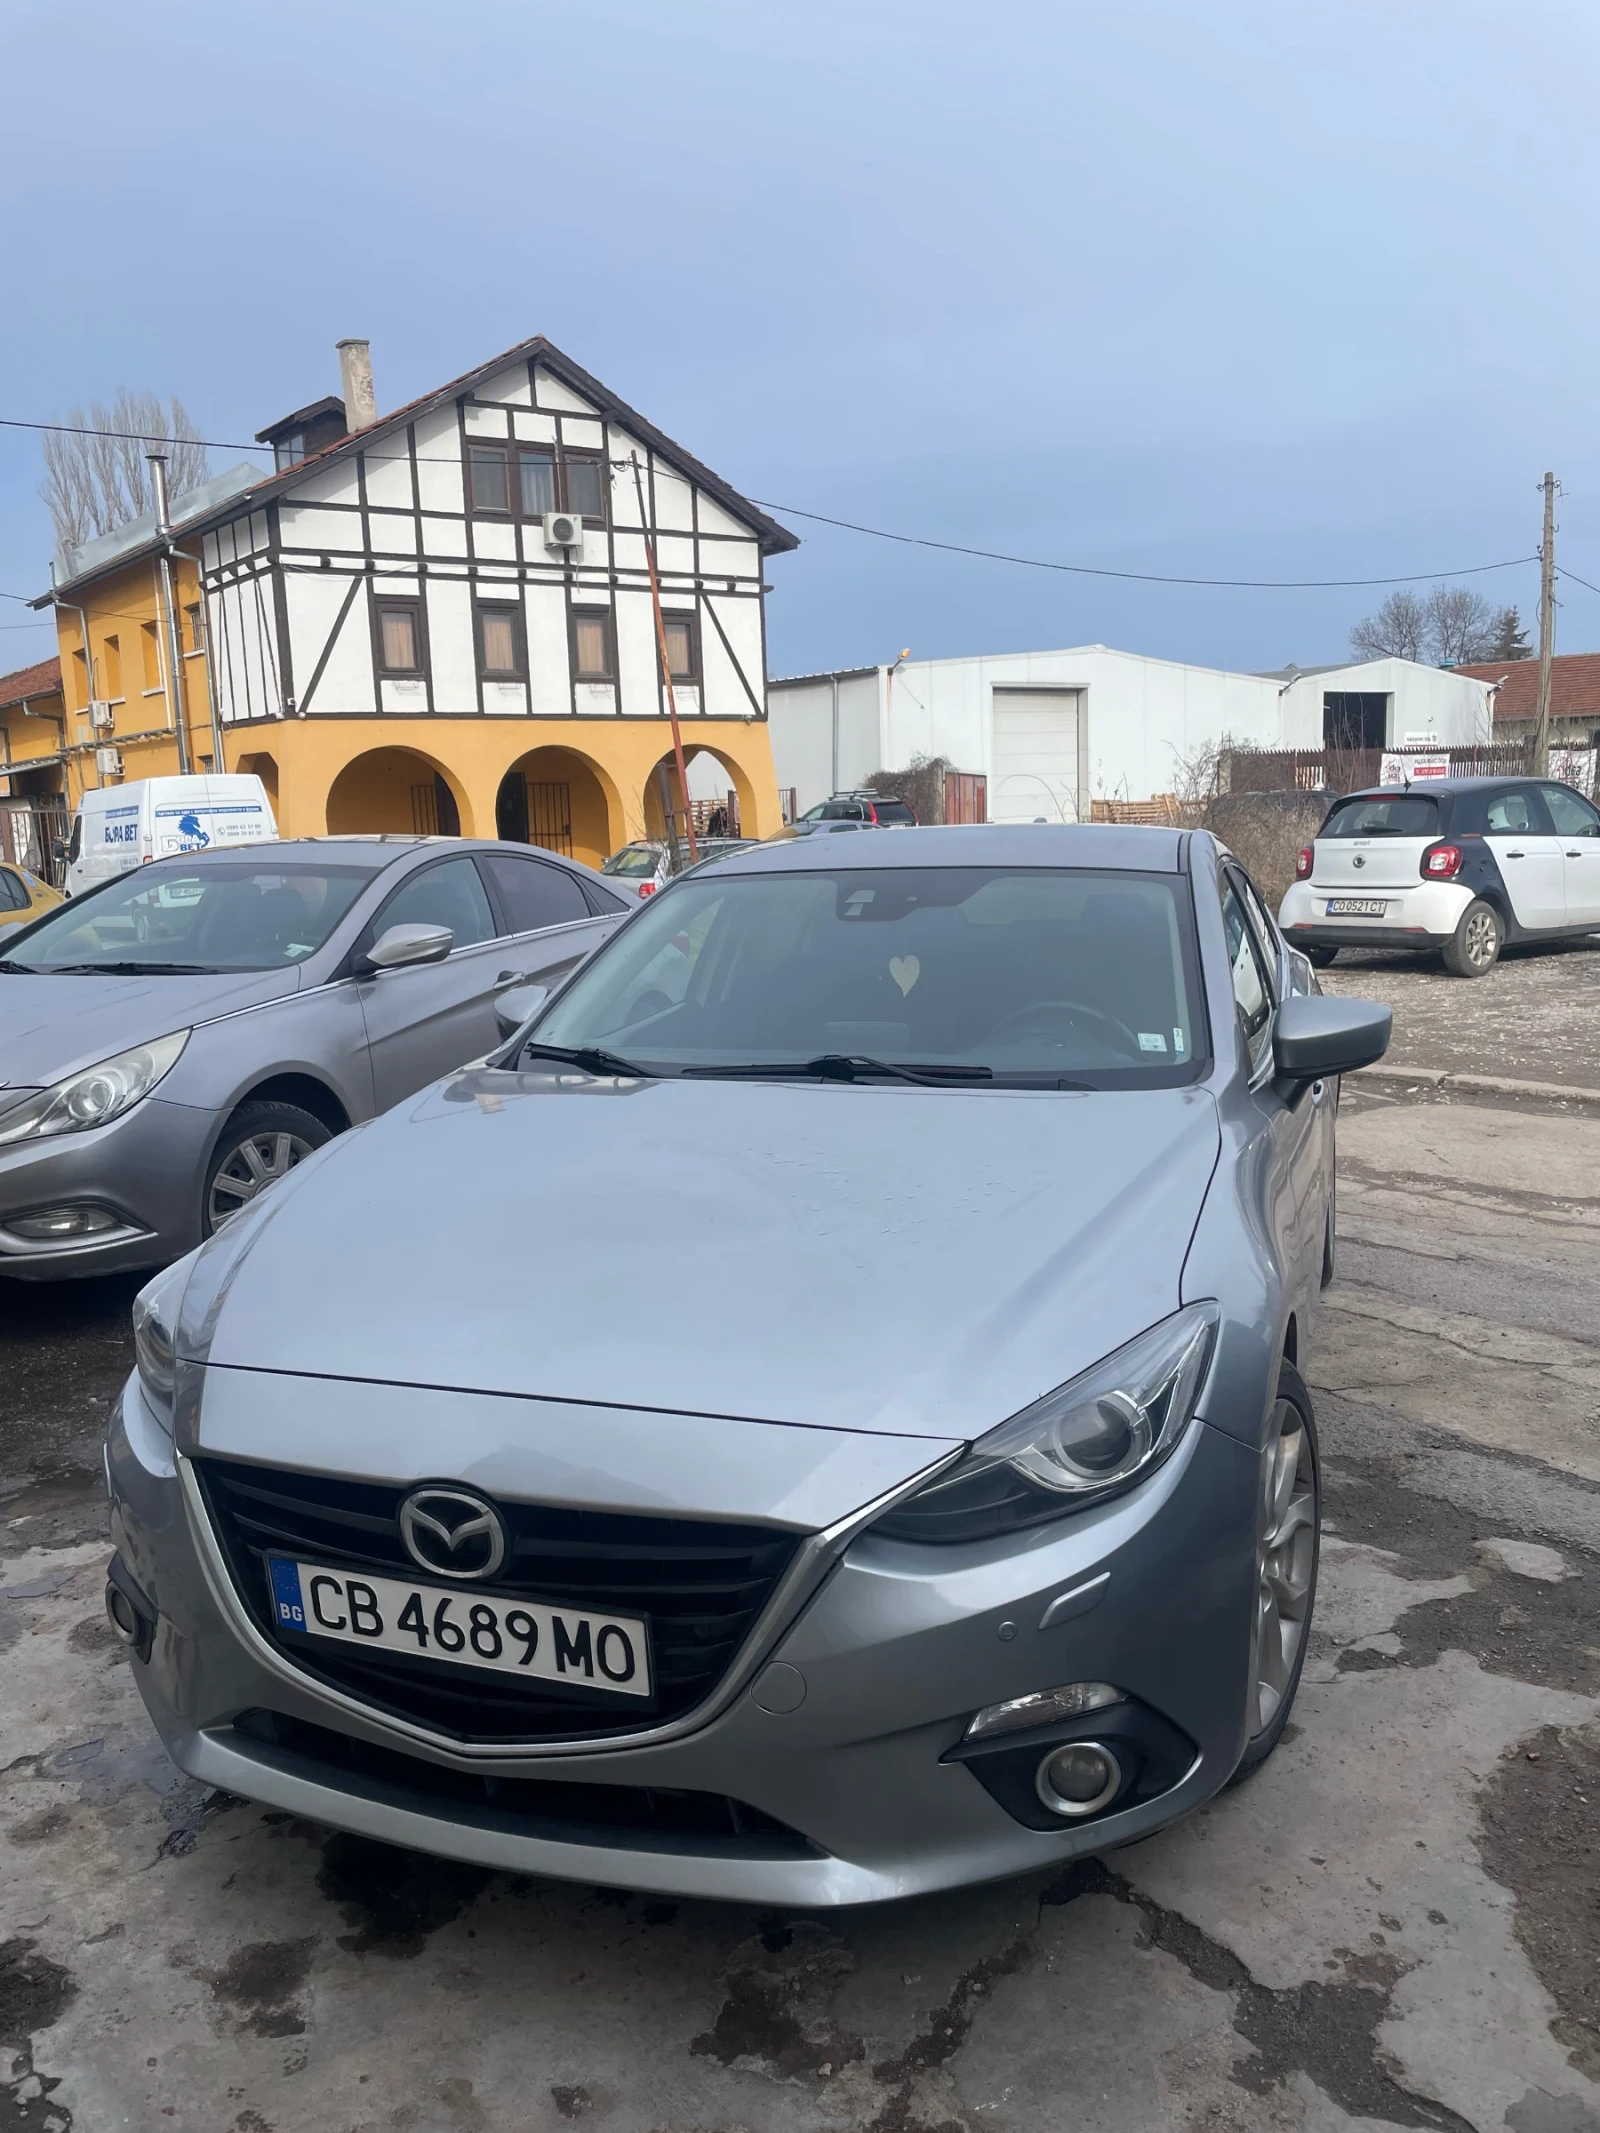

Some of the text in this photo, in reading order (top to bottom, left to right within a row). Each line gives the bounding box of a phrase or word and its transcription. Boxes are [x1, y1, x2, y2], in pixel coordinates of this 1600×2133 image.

[124, 824, 138, 841] ВЕТ
[180, 842, 201, 851] ВЕТ
[1346, 901, 1369, 911] 0521
[1370, 901, 1384, 912] CT
[280, 1602, 303, 1622] BG
[310, 1574, 636, 1684] CB 4689 MO
